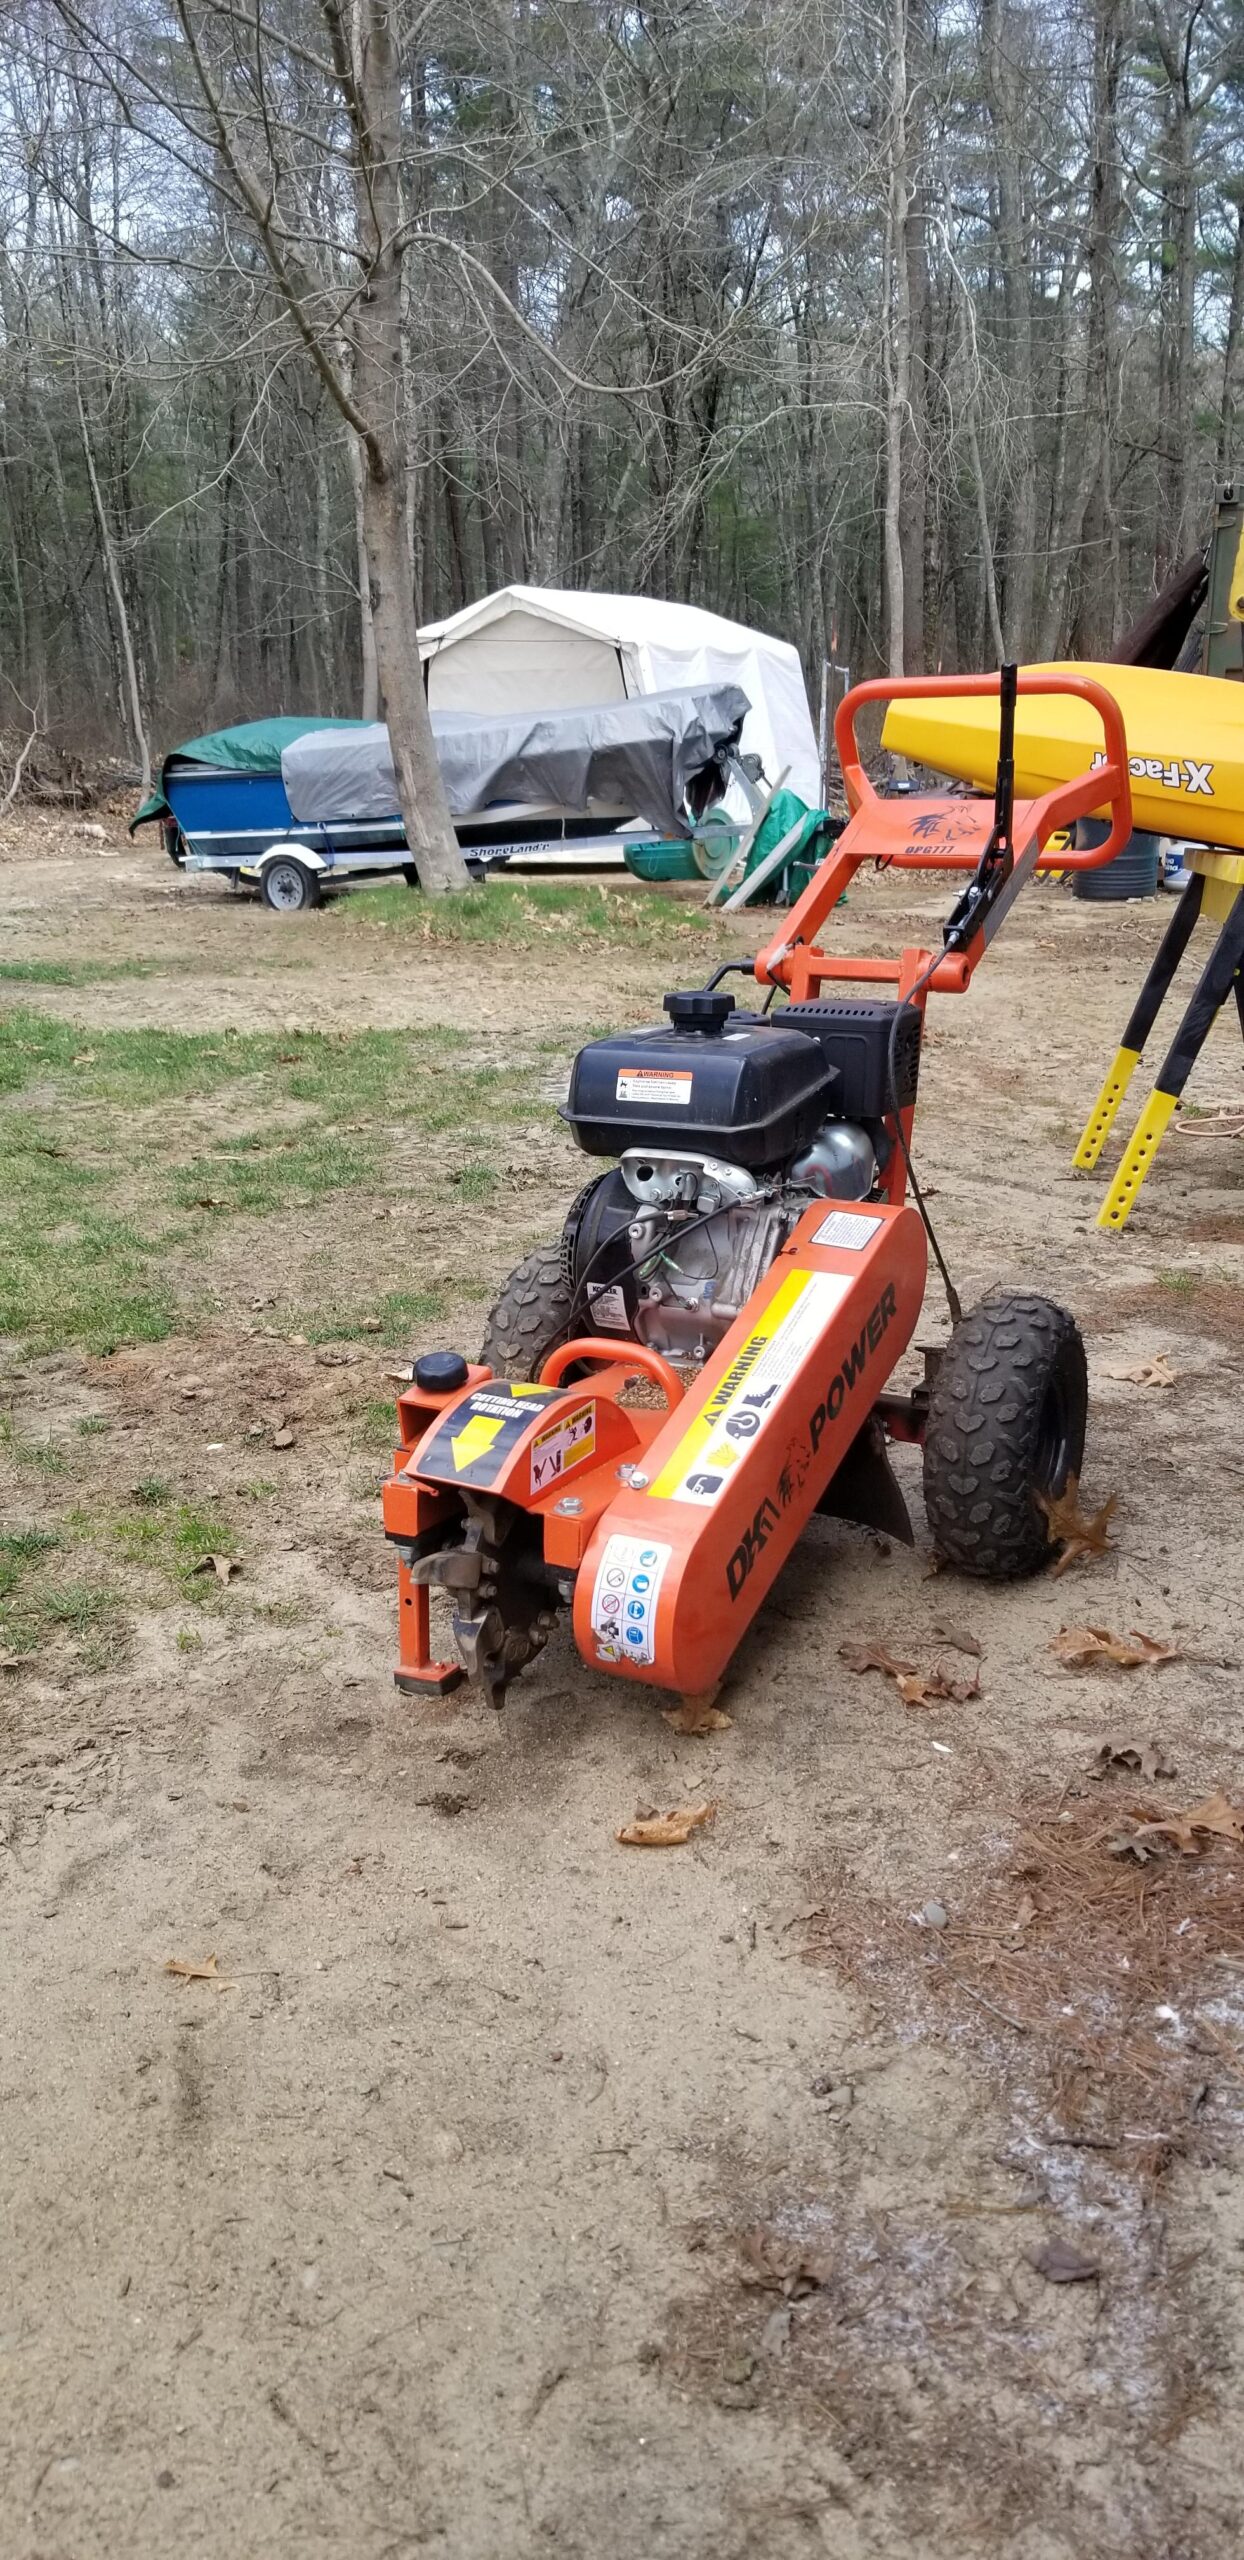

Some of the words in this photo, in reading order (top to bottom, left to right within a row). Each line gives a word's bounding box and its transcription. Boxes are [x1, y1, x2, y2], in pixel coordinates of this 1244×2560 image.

[1091, 752, 1214, 795] X-Facr
[470, 842, 549, 858] ShoreLand'r
[643, 1071, 674, 1079] WARNING
[711, 1336, 768, 1405] WARNING
[809, 1282, 896, 1454] POWER
[469, 1401, 524, 1418] ROTATION
[470, 1392, 518, 1407] CUTTING
[513, 1400, 545, 1412] HEAD
